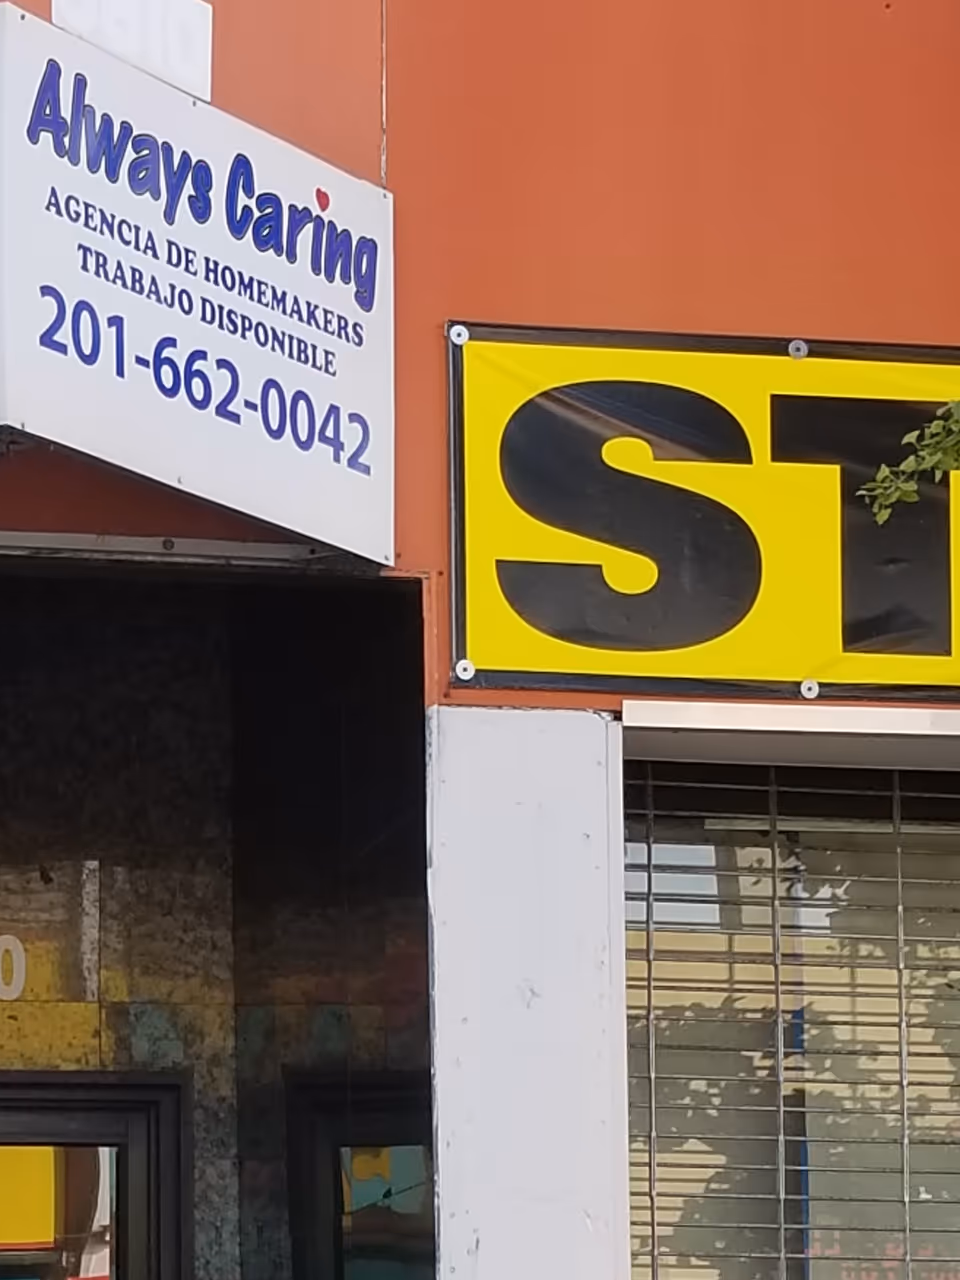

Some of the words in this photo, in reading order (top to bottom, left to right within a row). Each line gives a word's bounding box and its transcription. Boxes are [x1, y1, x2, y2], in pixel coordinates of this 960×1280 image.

[27, 58, 212, 226] Always
[225, 153, 378, 312] Caring
[45, 187, 160, 260] AGENCIA
[167, 239, 198, 276] DE
[204, 257, 365, 347] HOMEMAKERS
[40, 285, 371, 476] 201-662-0042
[78, 243, 194, 316] TRABAJO
[200, 296, 337, 377] DISPONIBLE
